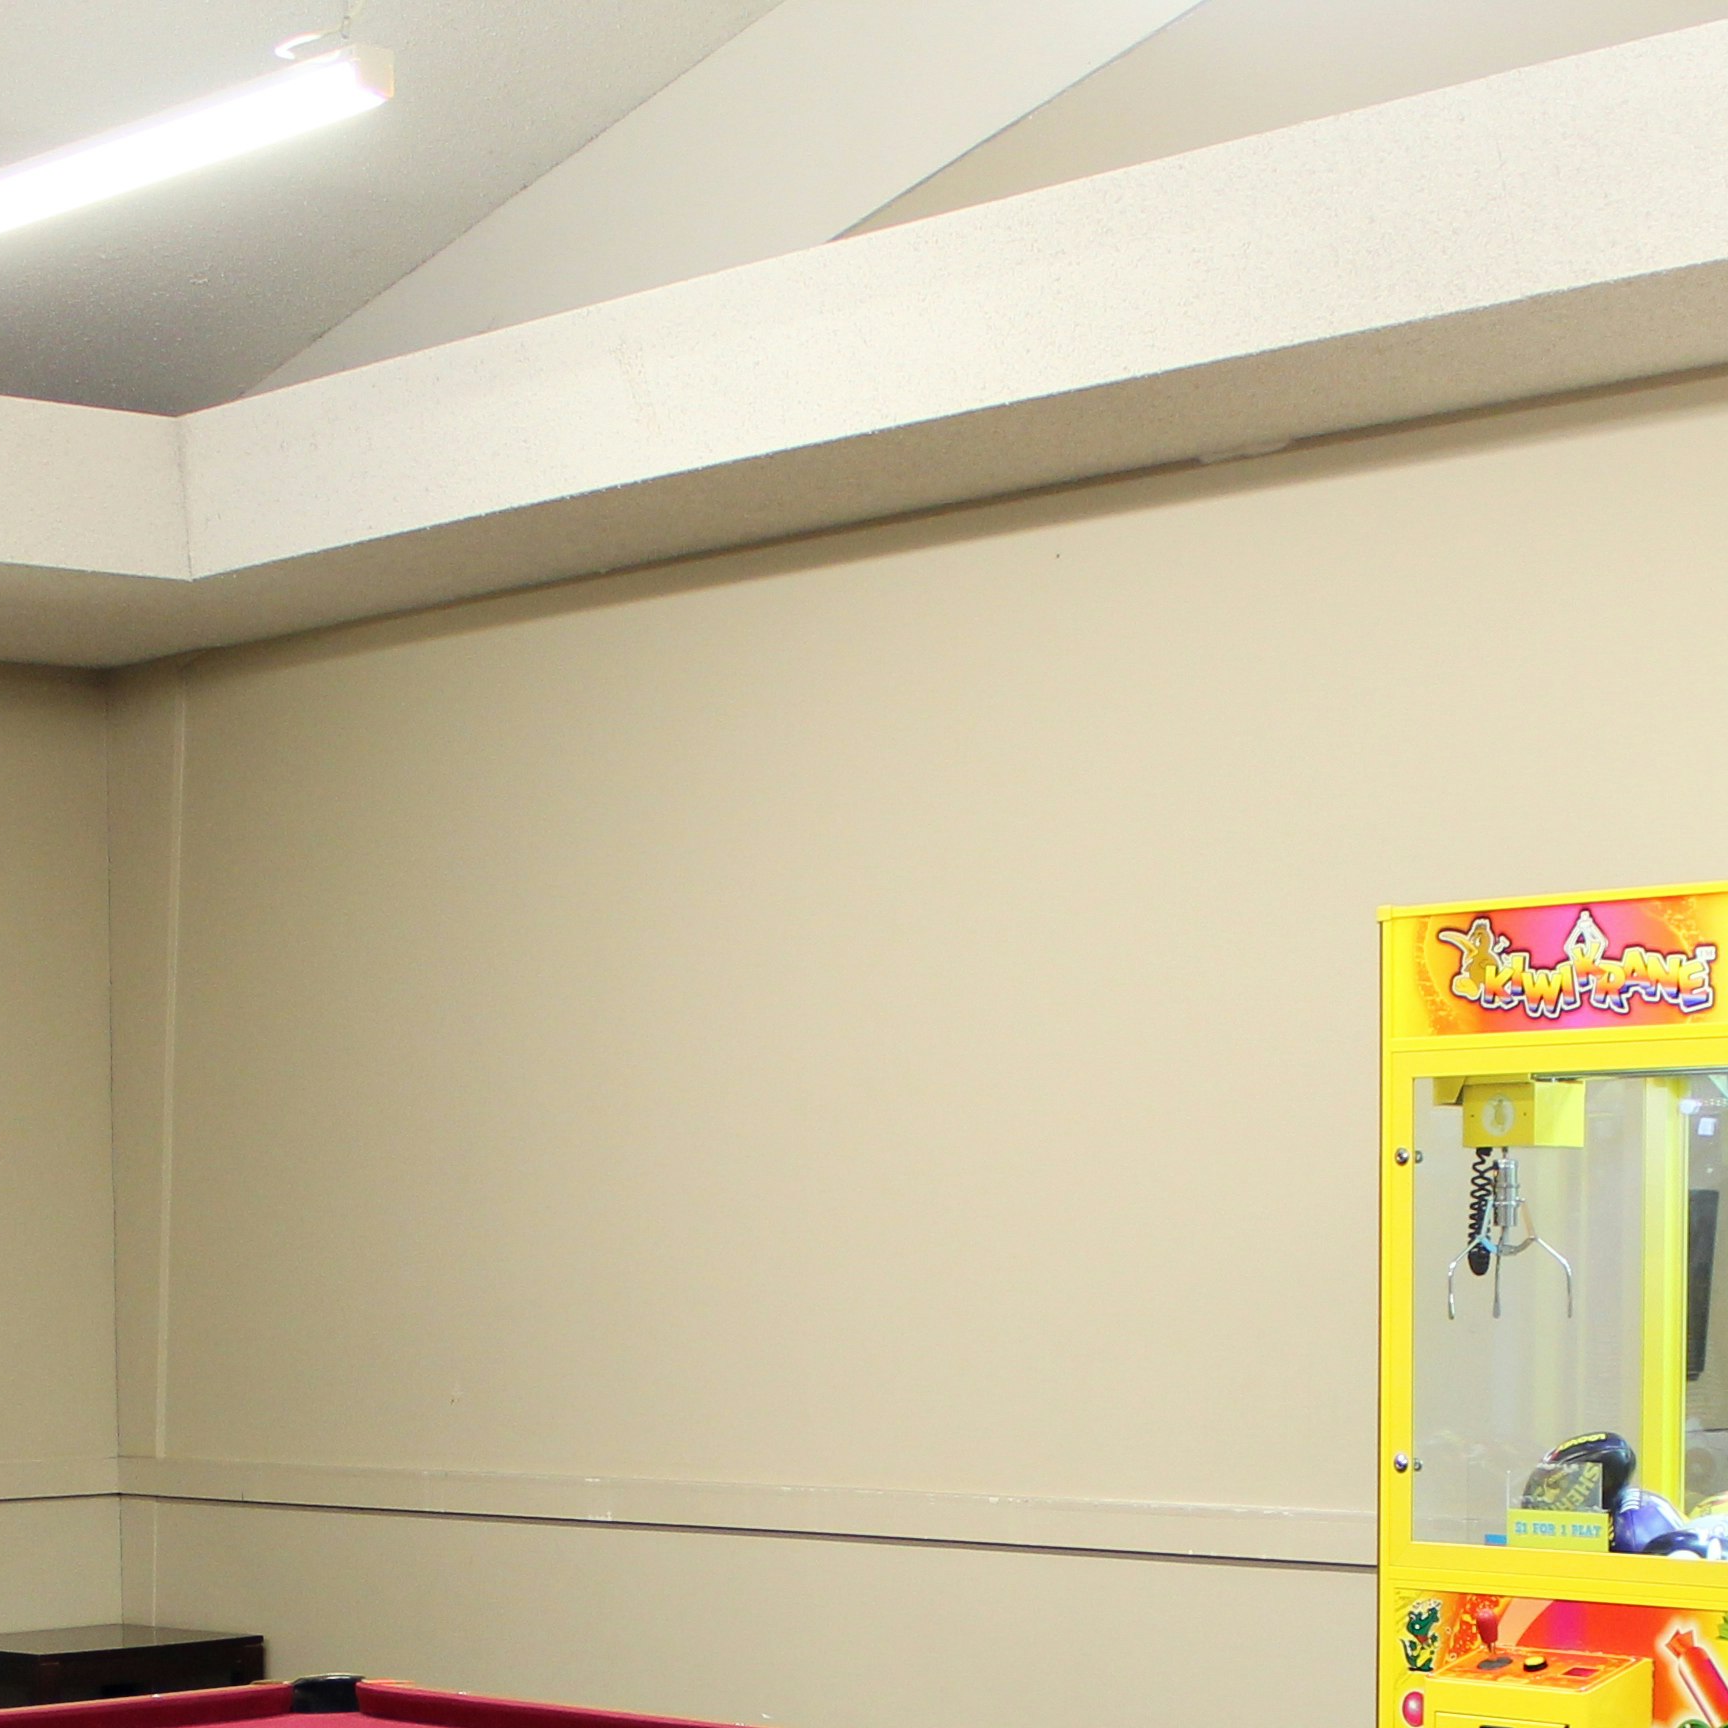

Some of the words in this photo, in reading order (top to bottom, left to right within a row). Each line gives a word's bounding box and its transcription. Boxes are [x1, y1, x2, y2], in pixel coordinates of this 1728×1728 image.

[1481, 951, 1580, 1018] KIWI
[1572, 942, 1714, 1014] KRANE
[1533, 1522, 1556, 1535] FOR
[1571, 1525, 1601, 1537] PLAY
